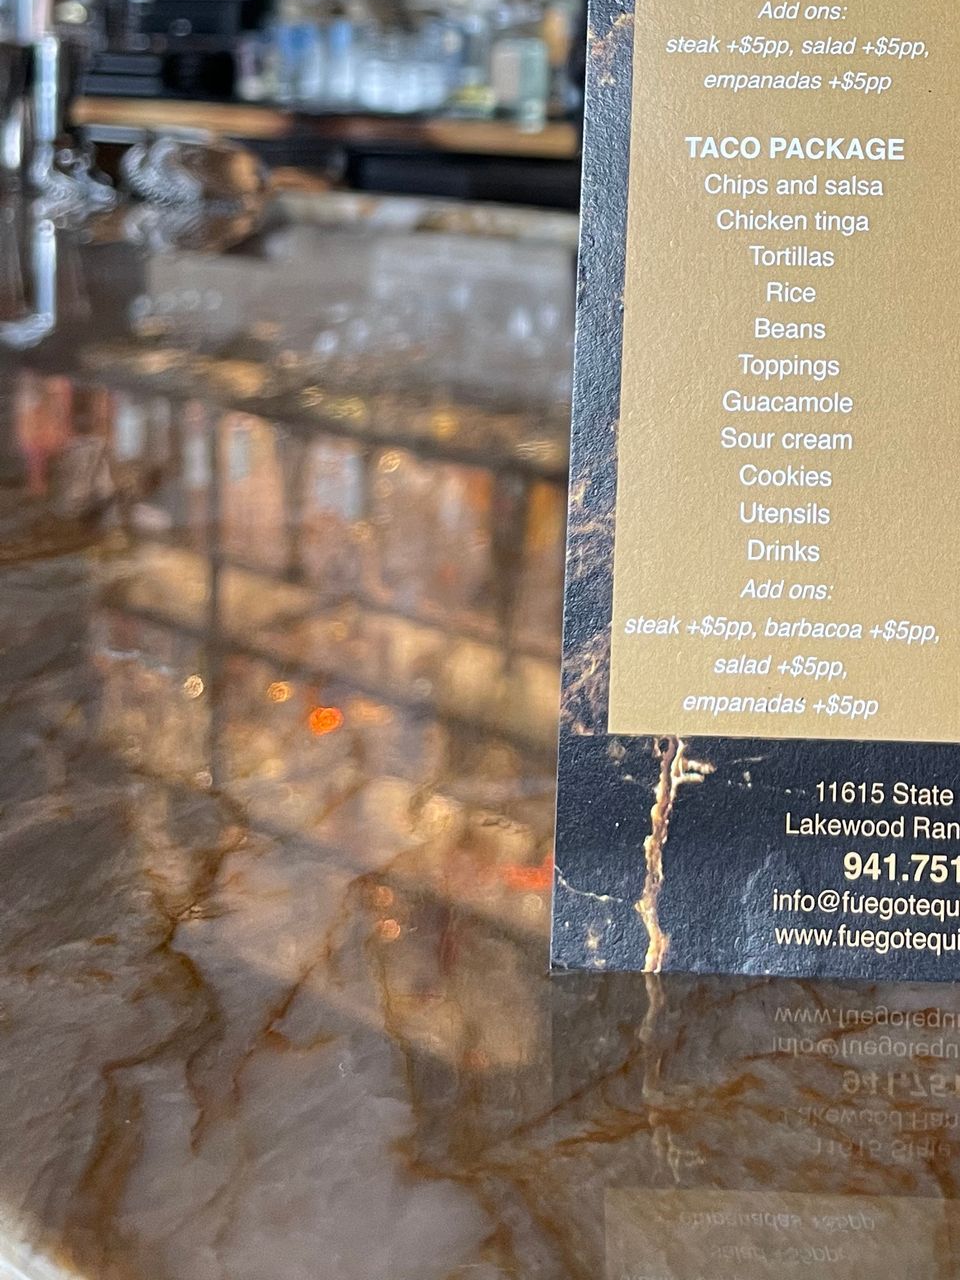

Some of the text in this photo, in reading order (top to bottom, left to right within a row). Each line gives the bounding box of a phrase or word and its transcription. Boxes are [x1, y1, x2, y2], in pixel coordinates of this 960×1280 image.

[758, 1, 848, 19] Add ons:
[666, 35, 929, 59] steak +$5pp, salad +$5pp,
[704, 71, 892, 94] empanadas +$5pp
[685, 137, 904, 160] TACO PACKAGE
[705, 174, 883, 199] Chips and salsa
[717, 209, 869, 236] Chicken tinga
[749, 246, 834, 266] Tortillas
[767, 282, 815, 302] Rice
[755, 318, 825, 339] Beans
[738, 354, 839, 381] Toppings
[723, 390, 852, 413] Guacamole
[721, 427, 852, 449] Sour cream
[740, 464, 831, 486] Cookies
[740, 502, 830, 524] Utensils
[748, 540, 819, 561] Drinks
[740, 579, 834, 599] Add ons:
[625, 615, 940, 645] steak +$5pp, barbacoa +$5pp,
[714, 655, 847, 680] salad +$5pp,
[683, 694, 879, 719] empanadas +$5pp
[816, 781, 884, 804] 11615
[892, 783, 954, 807] State
[785, 813, 905, 837] Lakewood
